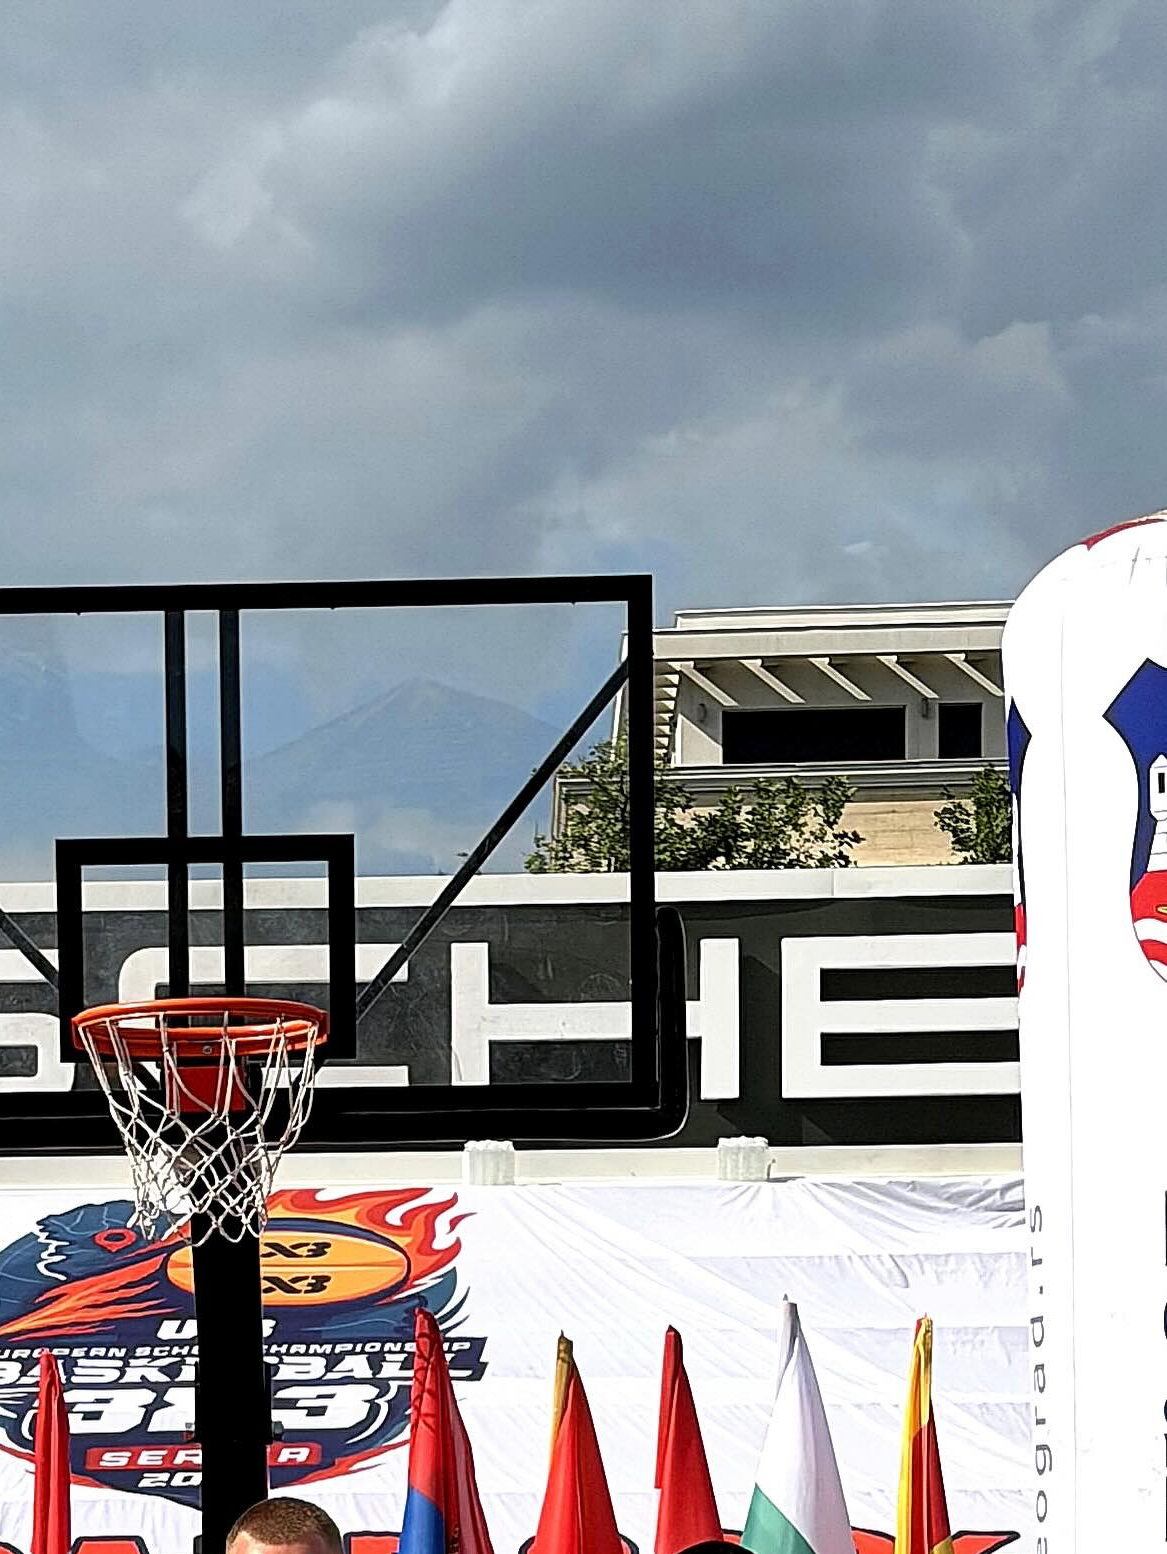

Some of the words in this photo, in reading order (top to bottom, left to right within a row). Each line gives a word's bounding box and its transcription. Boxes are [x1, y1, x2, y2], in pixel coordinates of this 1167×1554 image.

[260, 1242, 332, 1258] X3
[262, 1275, 332, 1294] X3
[135, 1344, 200, 1357] SCH
[99, 1447, 311, 1468] SERA
